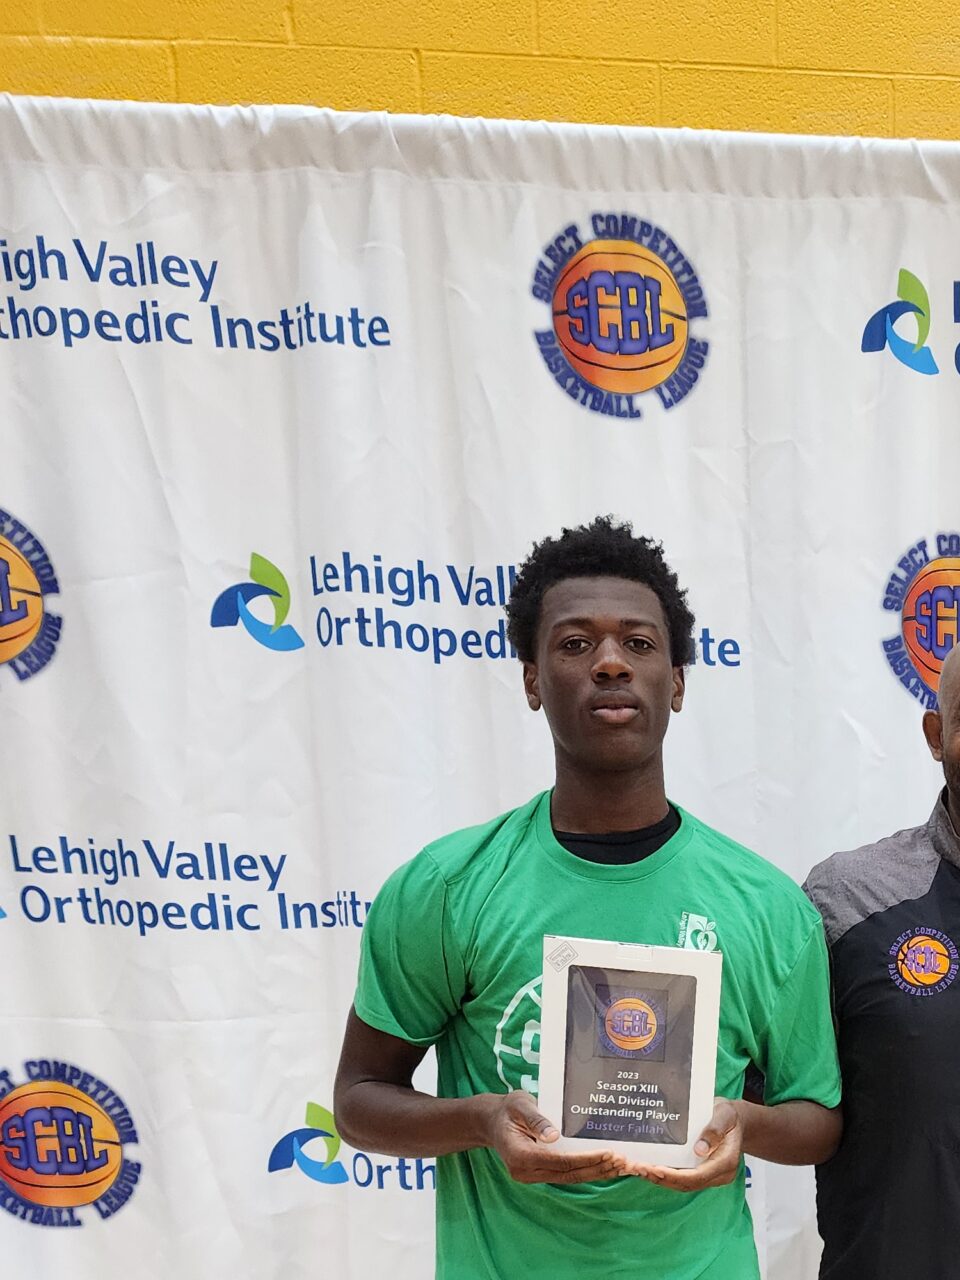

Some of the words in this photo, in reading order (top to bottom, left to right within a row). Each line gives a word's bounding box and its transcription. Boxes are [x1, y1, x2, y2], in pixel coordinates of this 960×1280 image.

[0, 235, 68, 291] igh
[72, 239, 218, 302] Valley
[532, 225, 583, 300] SELECT
[592, 214, 708, 317] COMPETITION
[0, 296, 193, 347] hopedic
[210, 302, 391, 351] Institute
[566, 271, 674, 355] SCBL
[535, 331, 641, 418] BASKETBALL
[655, 337, 709, 410] LEAGUE
[310, 551, 440, 607] Lehigh
[446, 565, 516, 606] Vall
[883, 540, 930, 611] SELECT
[8, 612, 62, 681] LEAGUE
[317, 606, 517, 664] Orthoped
[8, 834, 140, 885] Lehigh
[142, 839, 287, 891] Valley
[19, 885, 261, 936] Orthopedic
[278, 890, 371, 930] Instit
[889, 929, 913, 956] SELECT
[915, 927, 959, 959] COMPETITION
[888, 963, 934, 996] BASKETBALL
[935, 963, 959, 993] LEAGUE
[611, 1009, 652, 1037] SCBL
[25, 1060, 138, 1144] COMPETITION
[589, 1093, 616, 1104] NBA
[618, 1095, 664, 1108] Division
[596, 1081, 637, 1092] Season
[639, 1084, 658, 1093] XIII
[617, 1071, 639, 1080] 2023
[2, 1106, 109, 1175] SCBL
[570, 1104, 643, 1121] Outstanding
[645, 1109, 681, 1122] Player
[586, 1120, 625, 1132] Buster
[94, 1159, 141, 1219] LEAGUE
